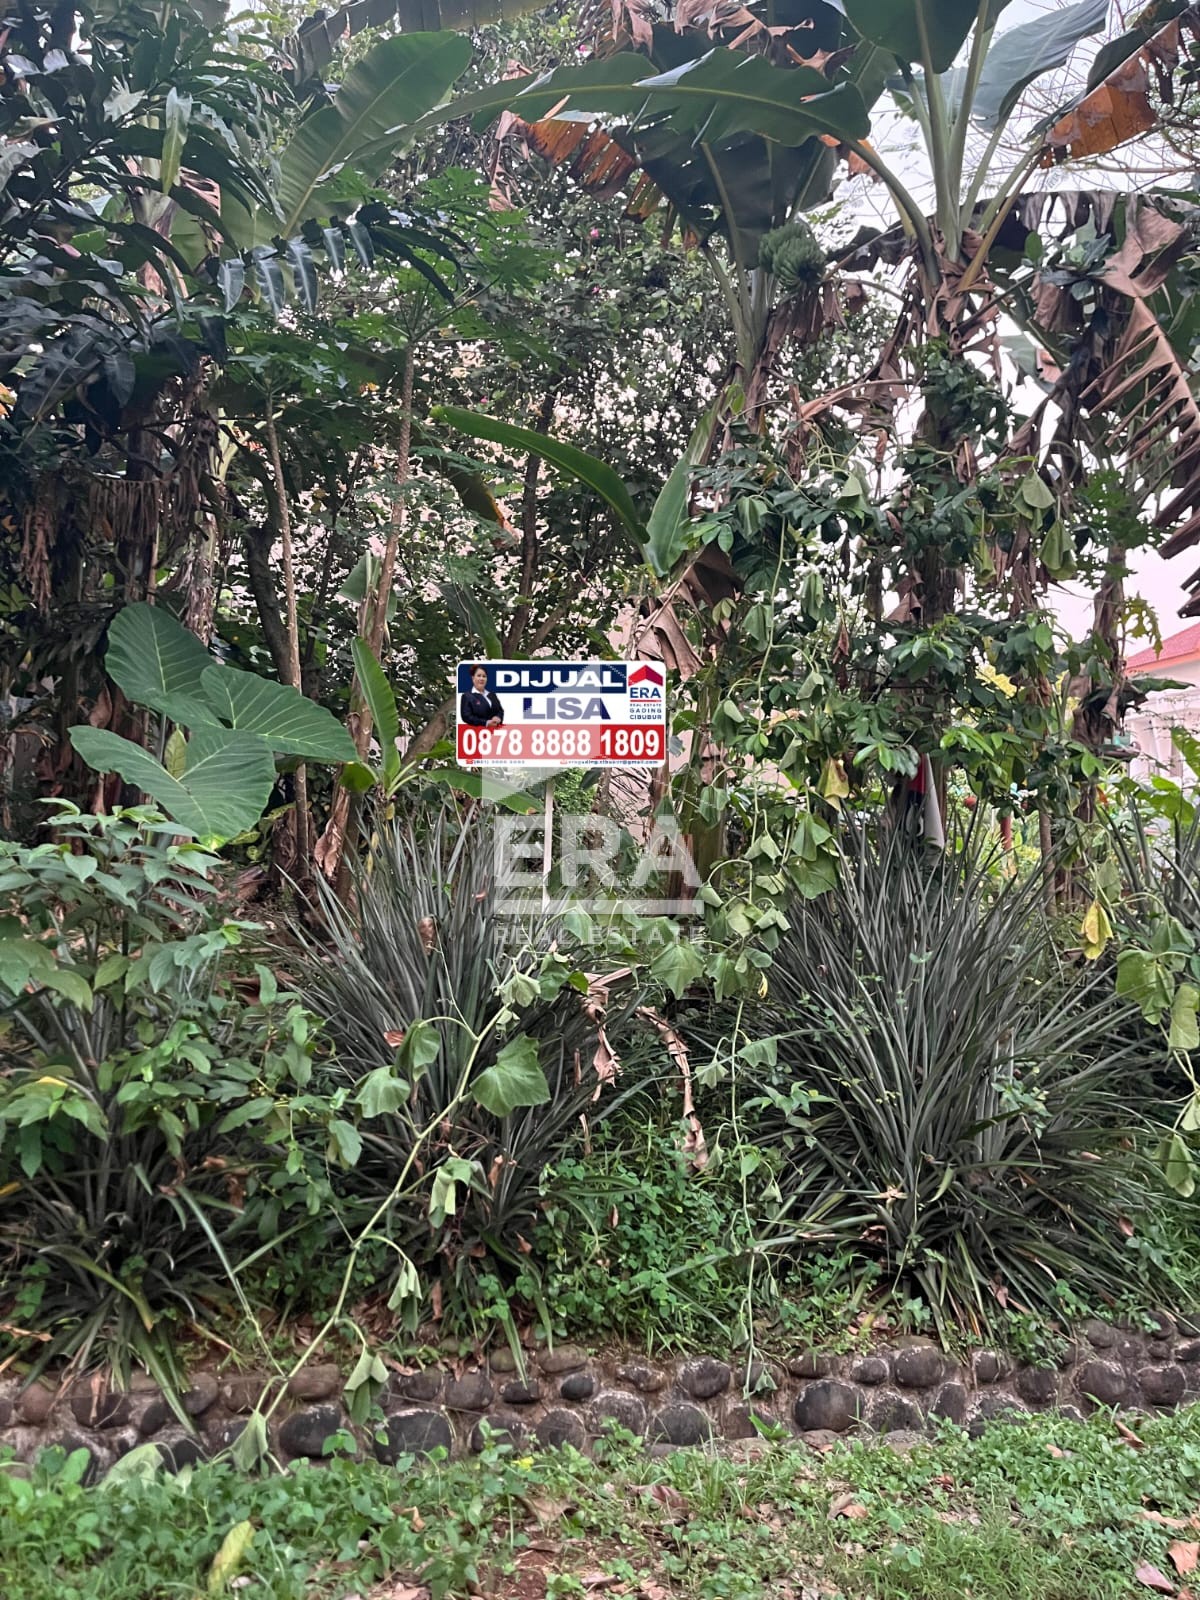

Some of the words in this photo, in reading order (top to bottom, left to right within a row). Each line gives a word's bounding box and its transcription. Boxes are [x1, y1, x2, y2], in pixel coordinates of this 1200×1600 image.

[495, 670, 624, 688] DIJUAL
[629, 687, 662, 699] ERA
[522, 697, 611, 720] LISA
[462, 728, 523, 757] 0878
[531, 728, 592, 757] 8888
[600, 728, 660, 757] 1809
